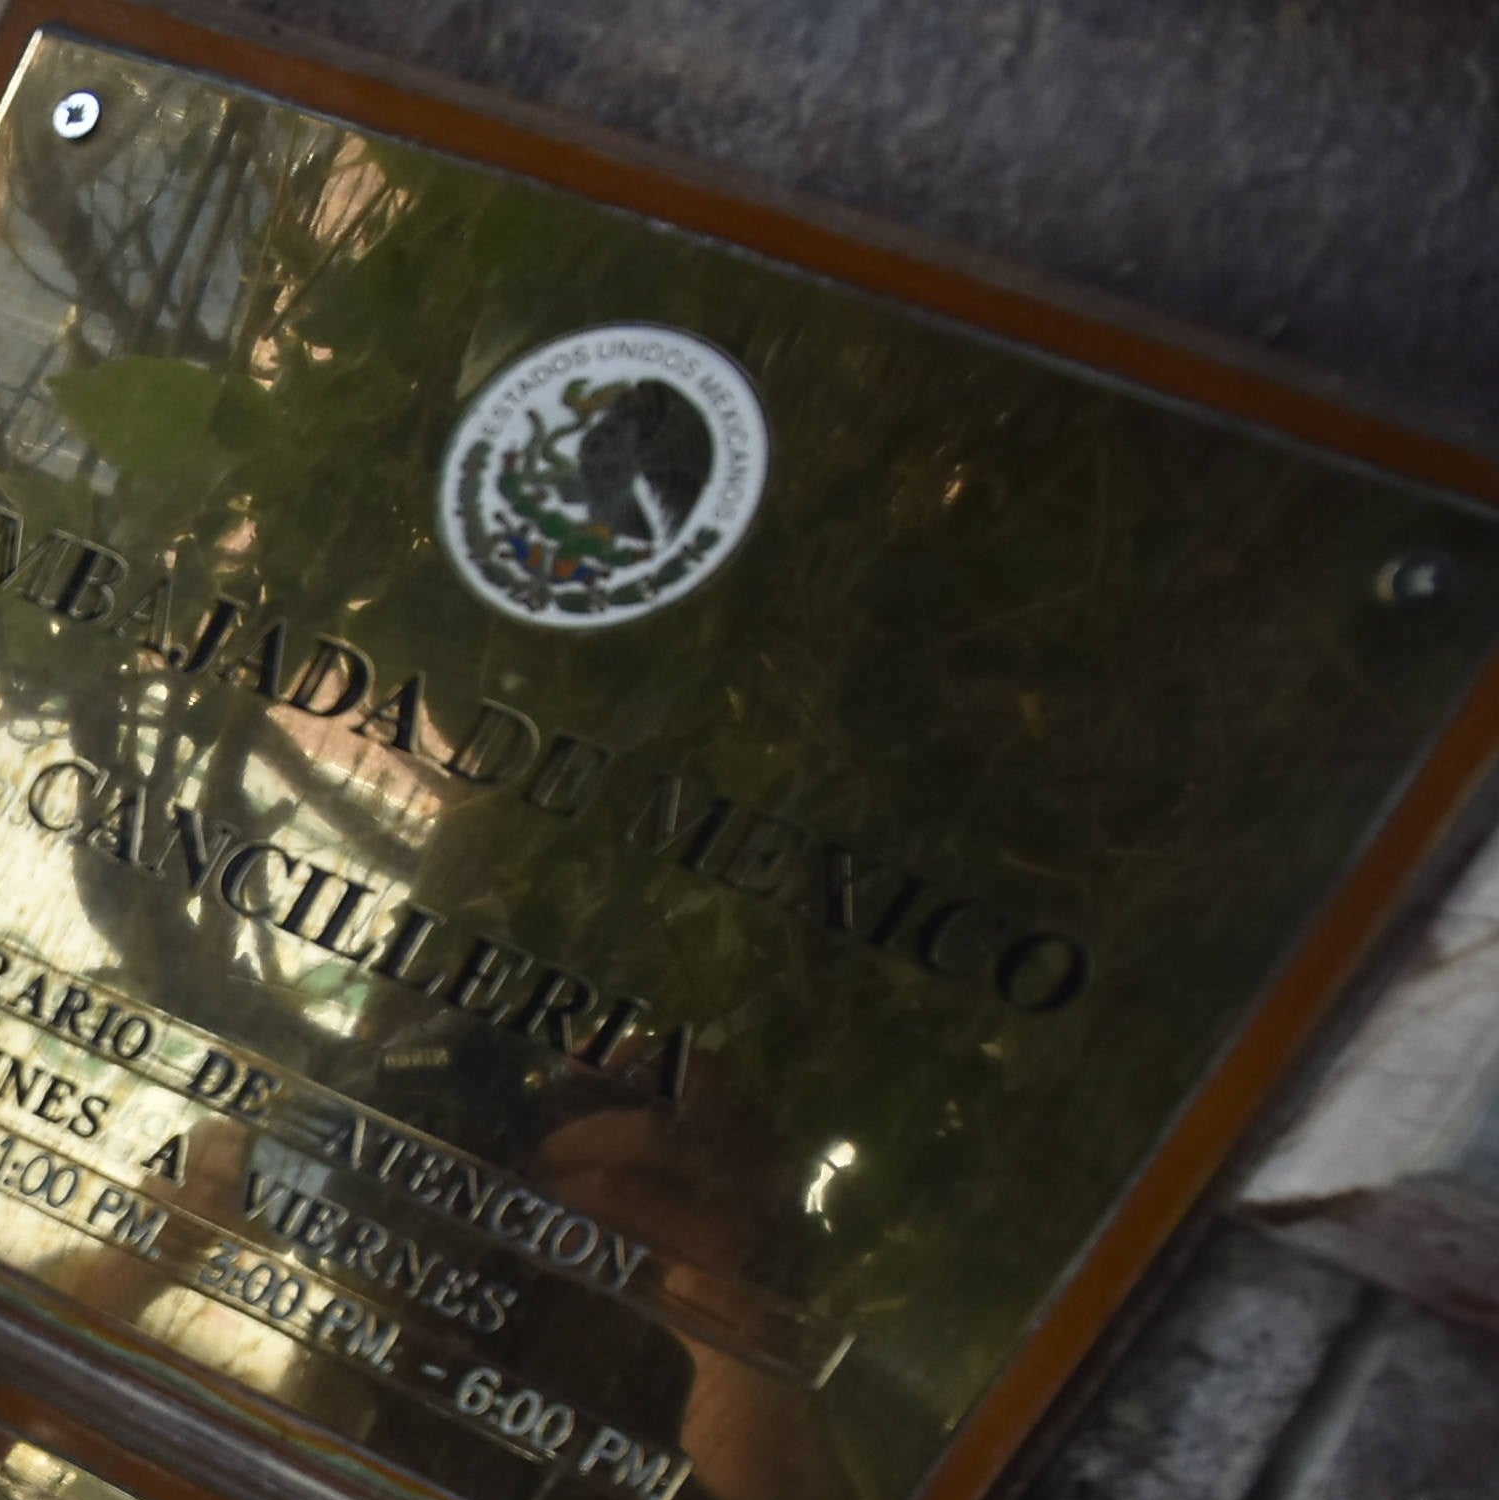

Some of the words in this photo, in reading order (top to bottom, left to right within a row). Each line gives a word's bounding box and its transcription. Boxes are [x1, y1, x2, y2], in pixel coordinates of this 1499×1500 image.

[595, 341, 702, 379] UNIDOS
[28, 757, 695, 1103] CANCILLERIA
[447, 697, 615, 818] DE
[625, 772, 1097, 1013] MEXICO
[142, 1133, 191, 1187] A
[240, 1168, 519, 1334] VIERNES
[187, 1048, 281, 1120] DE
[323, 1116, 652, 1292] ATENCION
[86, 1187, 171, 1260] PM.
[197, 1238, 305, 1320] 3:00
[314, 1294, 405, 1374] PM.
[455, 1364, 577, 1456] 6:00
